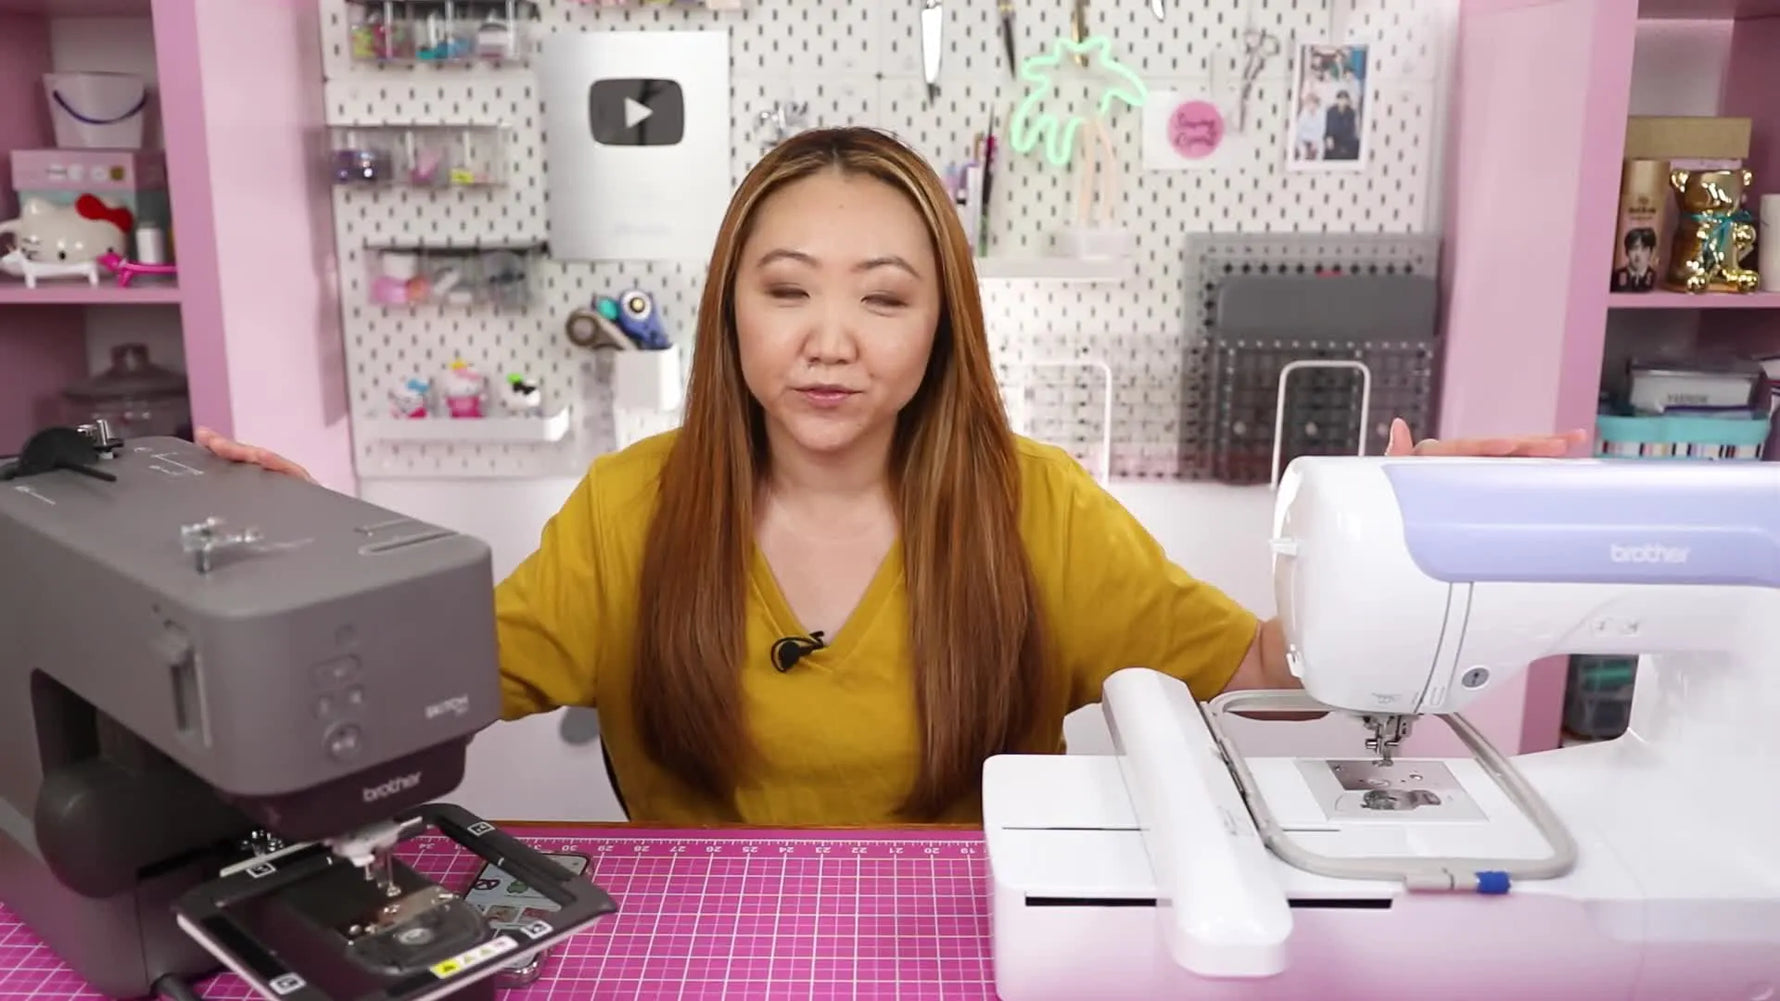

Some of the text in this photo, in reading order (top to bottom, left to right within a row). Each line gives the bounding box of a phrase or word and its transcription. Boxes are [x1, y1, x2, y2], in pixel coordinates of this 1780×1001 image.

[1610, 544, 1690, 563] brother
[362, 771, 422, 801] brother
[561, 844, 578, 852] 30
[669, 845, 687, 853] 27
[705, 845, 723, 853] 26
[778, 846, 795, 854] 24
[815, 846, 831, 854] 23
[888, 847, 904, 855] 21
[923, 847, 940, 855] 20
[960, 847, 976, 855] 19
